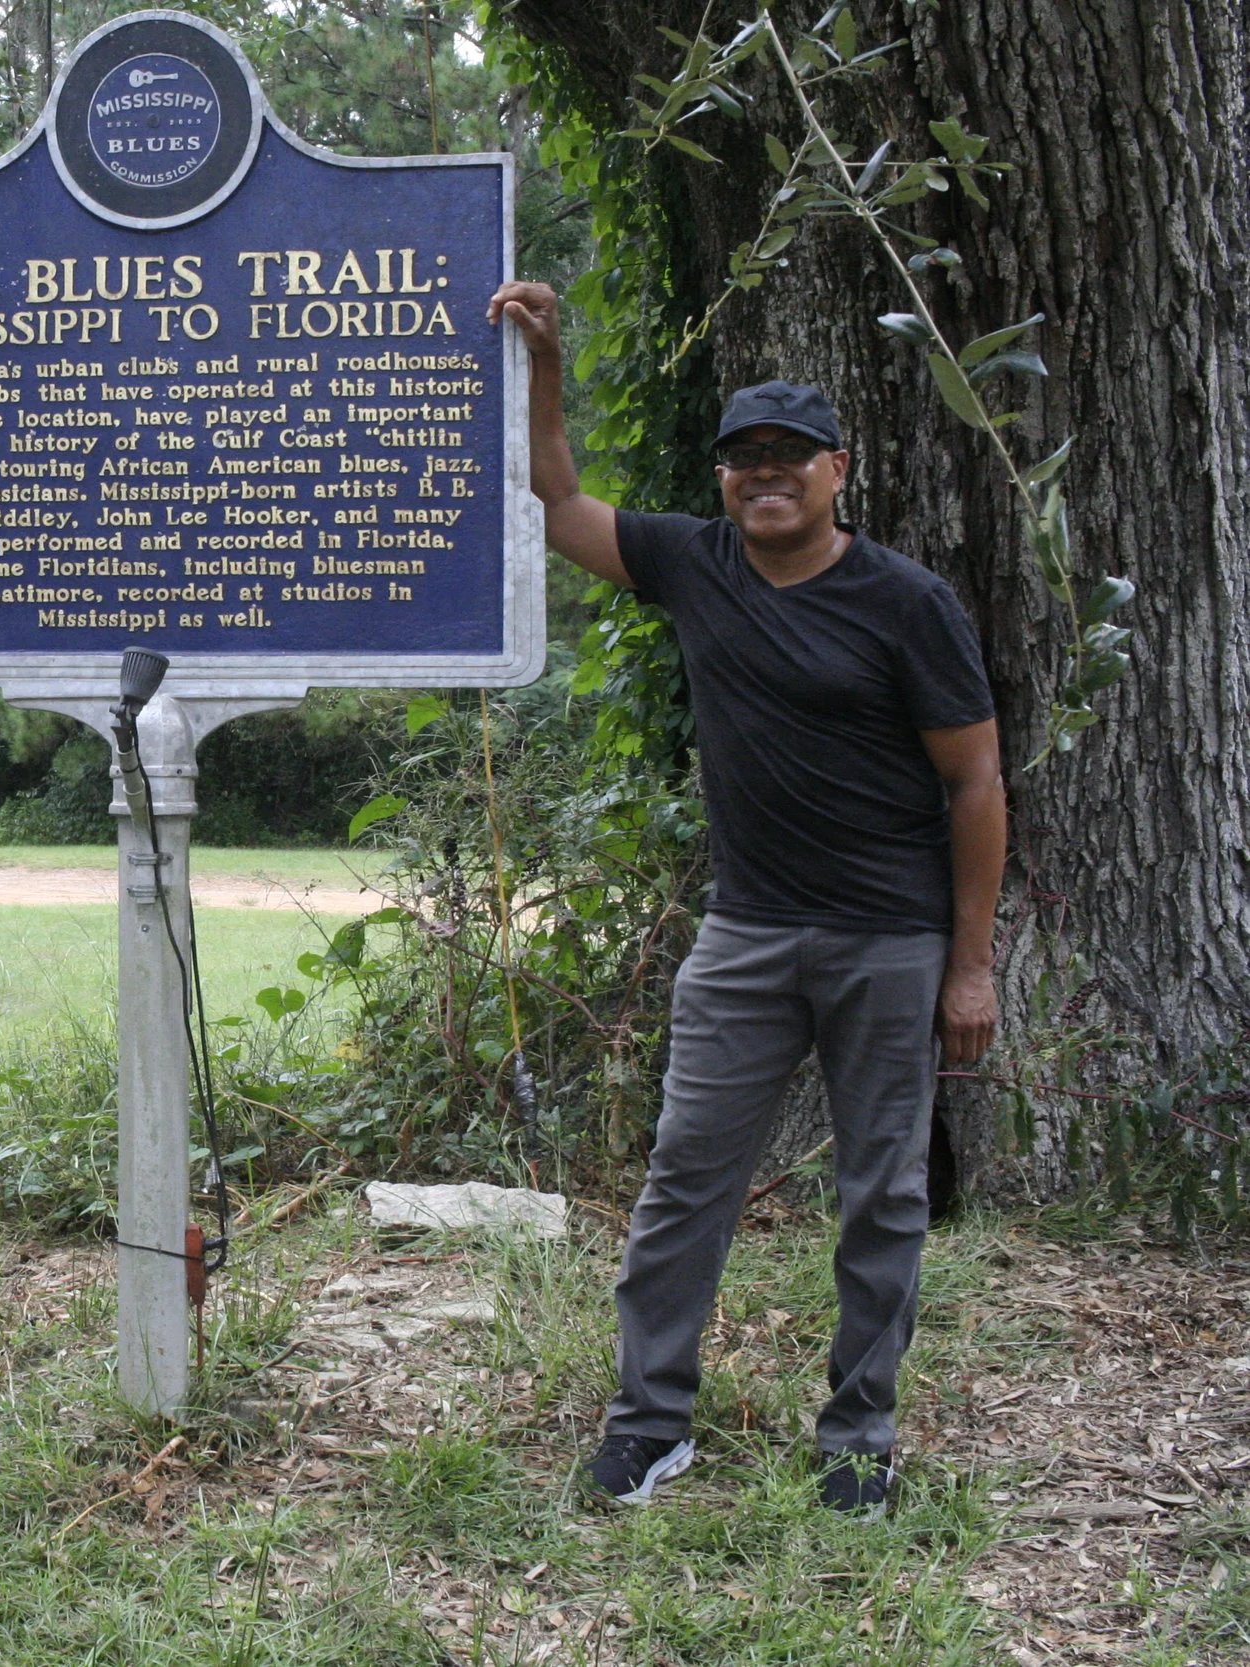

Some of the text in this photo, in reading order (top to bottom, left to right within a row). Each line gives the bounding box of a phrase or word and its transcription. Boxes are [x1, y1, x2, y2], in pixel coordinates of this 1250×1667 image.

[96, 92, 213, 118] MISSISSIPPI
[108, 136, 201, 154] BLUES
[110, 157, 197, 184] COMMISSION
[24, 255, 202, 303] BLUES
[238, 248, 448, 296] TRAIL:
[148, 304, 219, 341] TO
[249, 300, 456, 338] FLORIDA
[35, 357, 104, 377] urban
[117, 355, 179, 375] clubs
[195, 353, 240, 374] and
[256, 351, 319, 372] rural
[336, 350, 480, 371] roadhouses,
[37, 383, 87, 401] that
[100, 381, 154, 400] have
[167, 377, 275, 403] operated
[289, 378, 313, 397] at
[327, 376, 376, 396] this
[388, 376, 484, 396] historic
[17, 407, 121, 427] location,
[134, 406, 188, 425] have
[204, 403, 288, 428] played
[302, 406, 333, 423] an
[347, 401, 473, 425] important
[9, 431, 99, 454] history
[114, 431, 141, 450] of
[156, 431, 196, 449] the
[211, 428, 265, 448] Gulf
[279, 428, 348, 447] Coast
[98, 456, 189, 476] African
[207, 455, 322, 474] American
[338, 453, 409, 474] blues,
[423, 452, 483, 477] jazz,
[99, 480, 297, 504] Mississippi-born
[313, 478, 398, 498] artists
[418, 477, 441, 498] B.
[450, 477, 475, 497] B.
[96, 506, 153, 525] John
[165, 506, 208, 525] Lee
[223, 505, 319, 526] Hooker,
[333, 504, 379, 523] and
[393, 508, 462, 526] many
[139, 531, 182, 550] and
[196, 529, 304, 549] recorded
[317, 530, 342, 548] in
[357, 528, 454, 549] Florida,
[38, 556, 167, 577] Floridians,
[184, 555, 296, 579] including
[312, 555, 426, 574] bluesman
[117, 582, 224, 601] recorded
[238, 583, 264, 600] at
[281, 582, 373, 601] studios
[388, 581, 413, 600] in
[38, 606, 272, 632] Mississippi as well.
